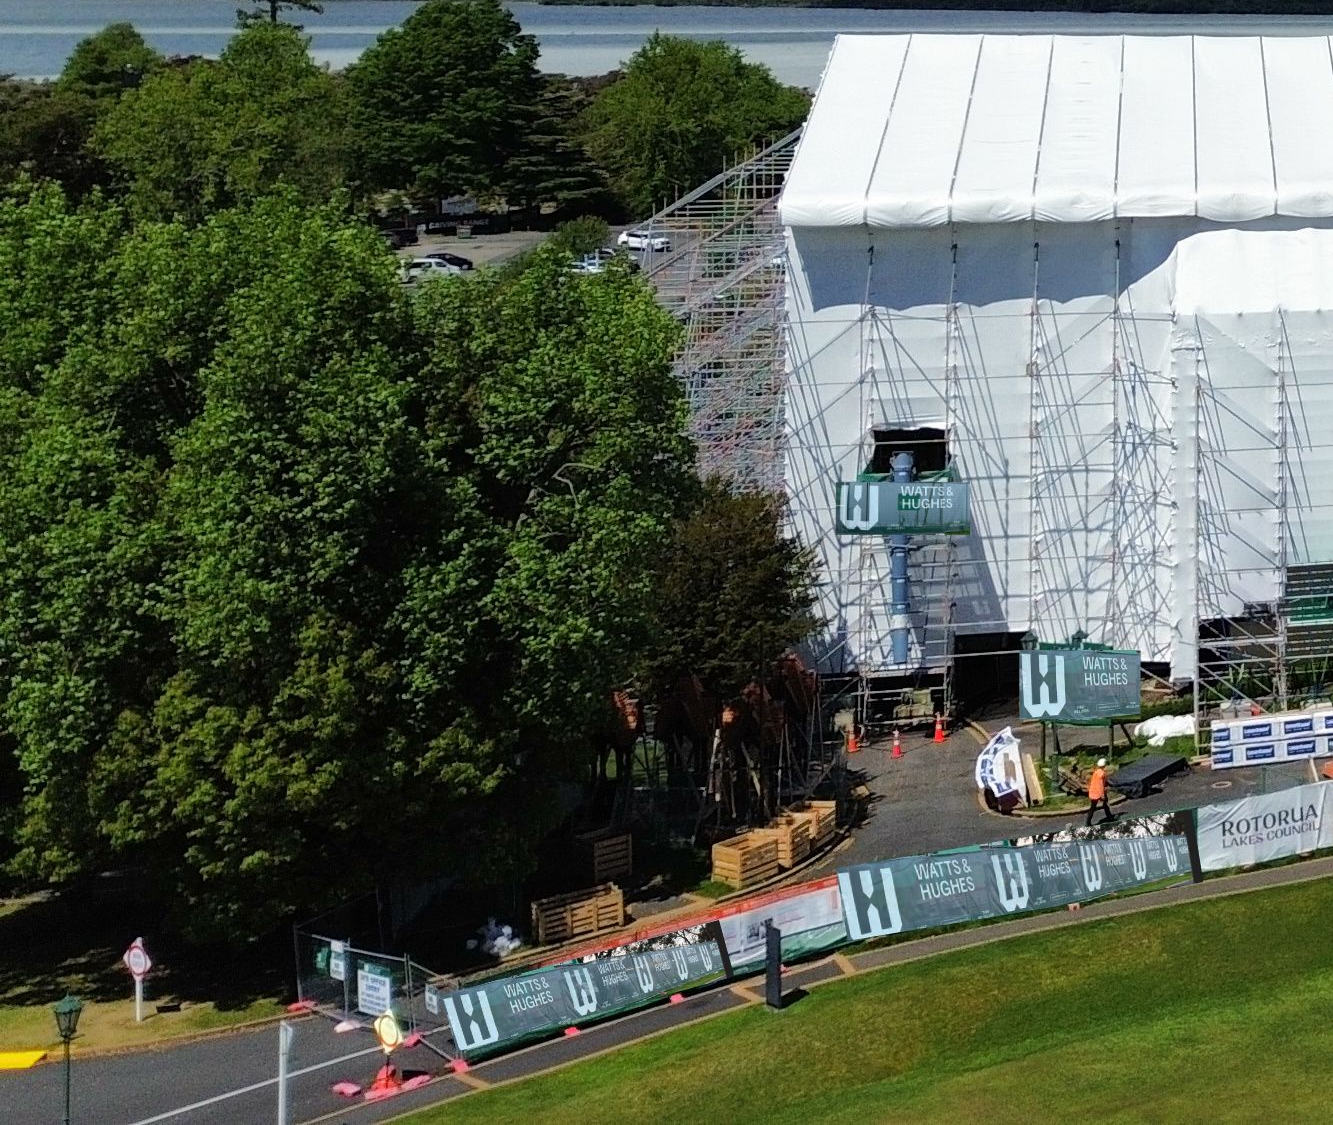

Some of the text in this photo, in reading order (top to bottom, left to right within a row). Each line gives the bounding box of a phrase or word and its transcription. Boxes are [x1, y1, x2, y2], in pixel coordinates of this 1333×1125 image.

[900, 486, 945, 496] WATTS
[902, 498, 952, 509] HUGHES
[1083, 656, 1120, 670] WATTS
[1084, 673, 1128, 686] HUGHES
[1221, 804, 1319, 836] ROTORUA
[1222, 820, 1320, 849] LAKES COUNCIL
[1033, 848, 1061, 862] WATTS
[913, 861, 961, 880] WATTS
[1038, 861, 1071, 878] HUGHES
[920, 877, 975, 900] HUGHES
[597, 963, 620, 975] WATTS
[601, 970, 629, 986] HUGHES
[503, 978, 541, 998] WATTS
[509, 990, 554, 1014] HUGHES
